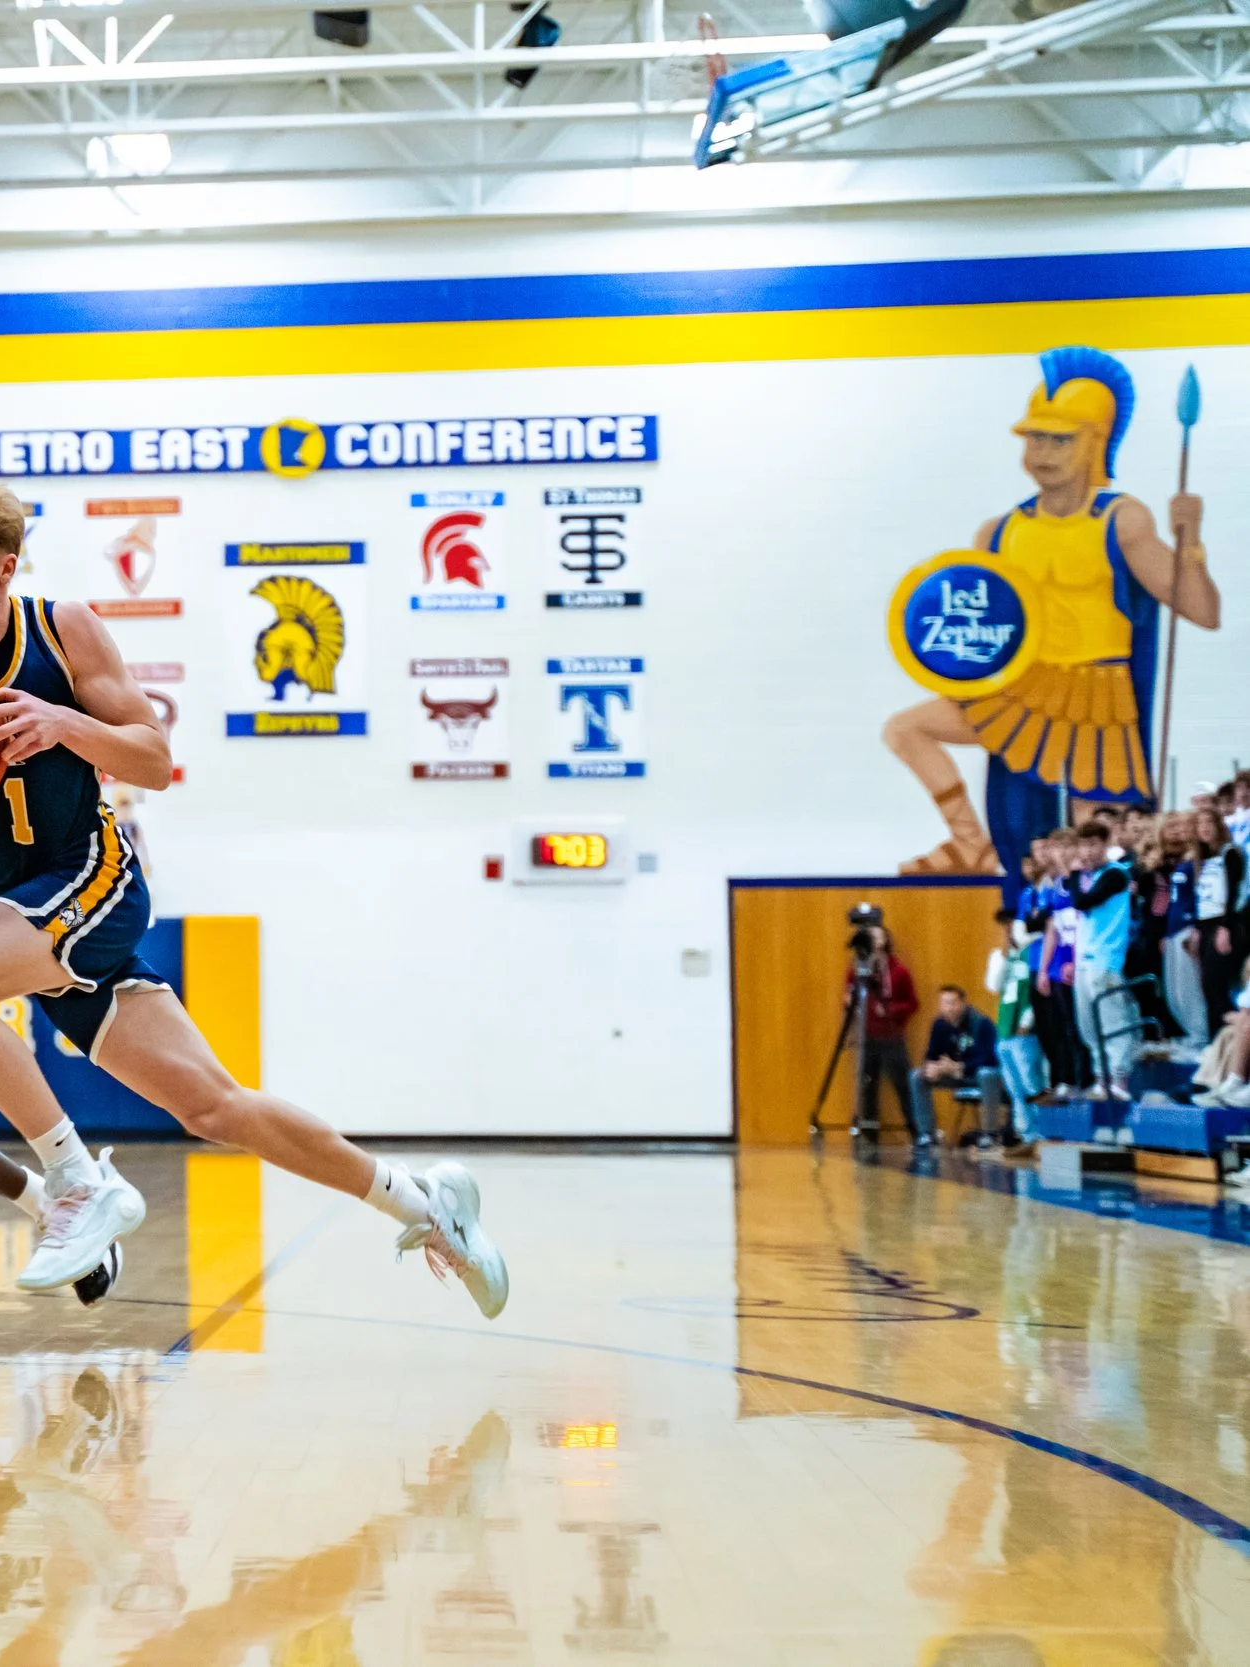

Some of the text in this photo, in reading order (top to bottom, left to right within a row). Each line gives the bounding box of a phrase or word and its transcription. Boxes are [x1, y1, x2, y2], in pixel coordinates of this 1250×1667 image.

[130, 427, 249, 472] EAST
[335, 416, 646, 467] CONFERENCE
[941, 579, 988, 617] Led
[921, 615, 1016, 663] Zephyr
[3, 777, 35, 846] 1
